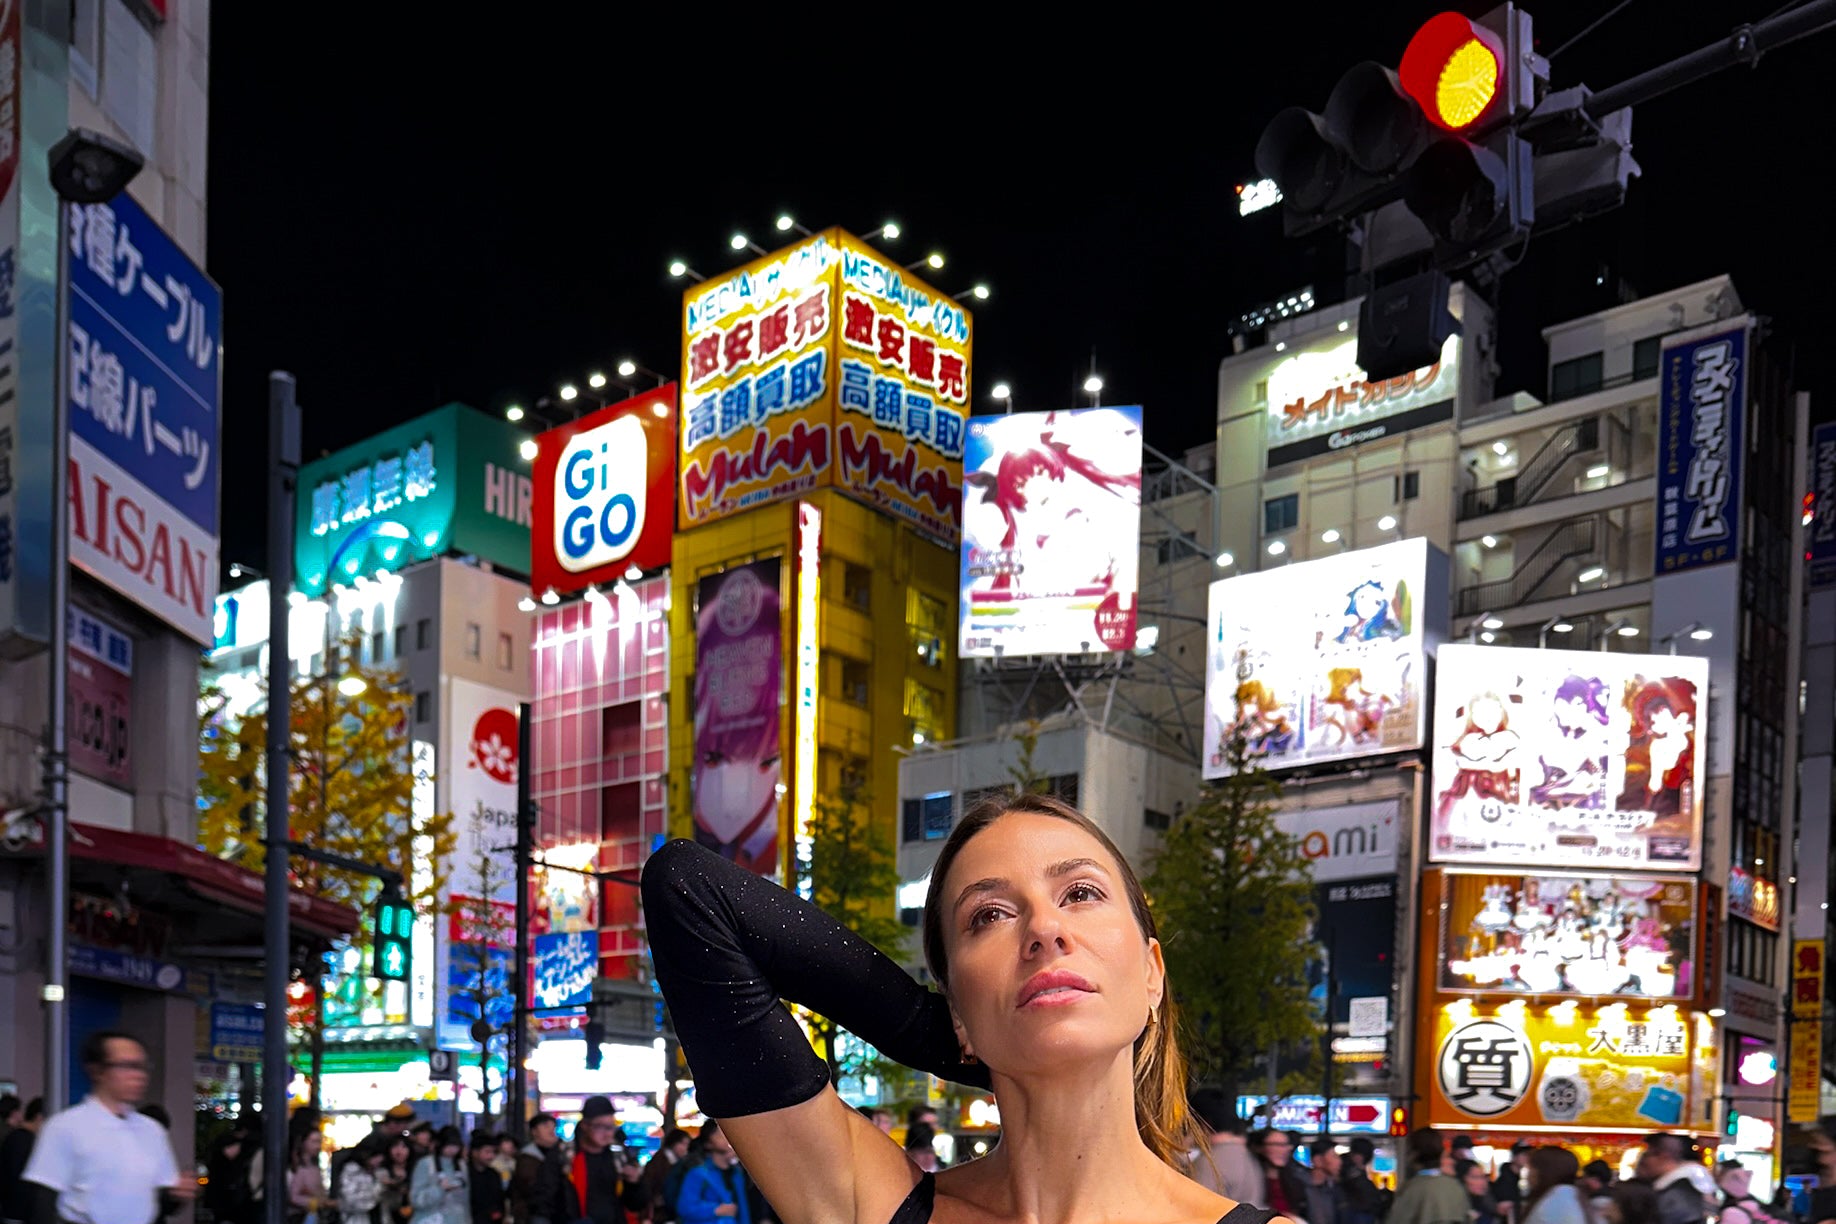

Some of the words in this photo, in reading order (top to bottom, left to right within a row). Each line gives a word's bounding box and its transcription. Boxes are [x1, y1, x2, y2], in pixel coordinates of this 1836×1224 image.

[844, 294, 964, 399] 激安販売
[688, 350, 824, 447] 高額買取
[841, 360, 962, 452] 高額買取
[564, 441, 608, 500] Gi
[685, 422, 829, 517] Mulan
[840, 425, 963, 531] Mulan
[70, 457, 207, 618] AISAN
[563, 493, 636, 558] GO
[1452, 1036, 1519, 1102] 質
[1589, 1022, 1684, 1055] 大黒屋
